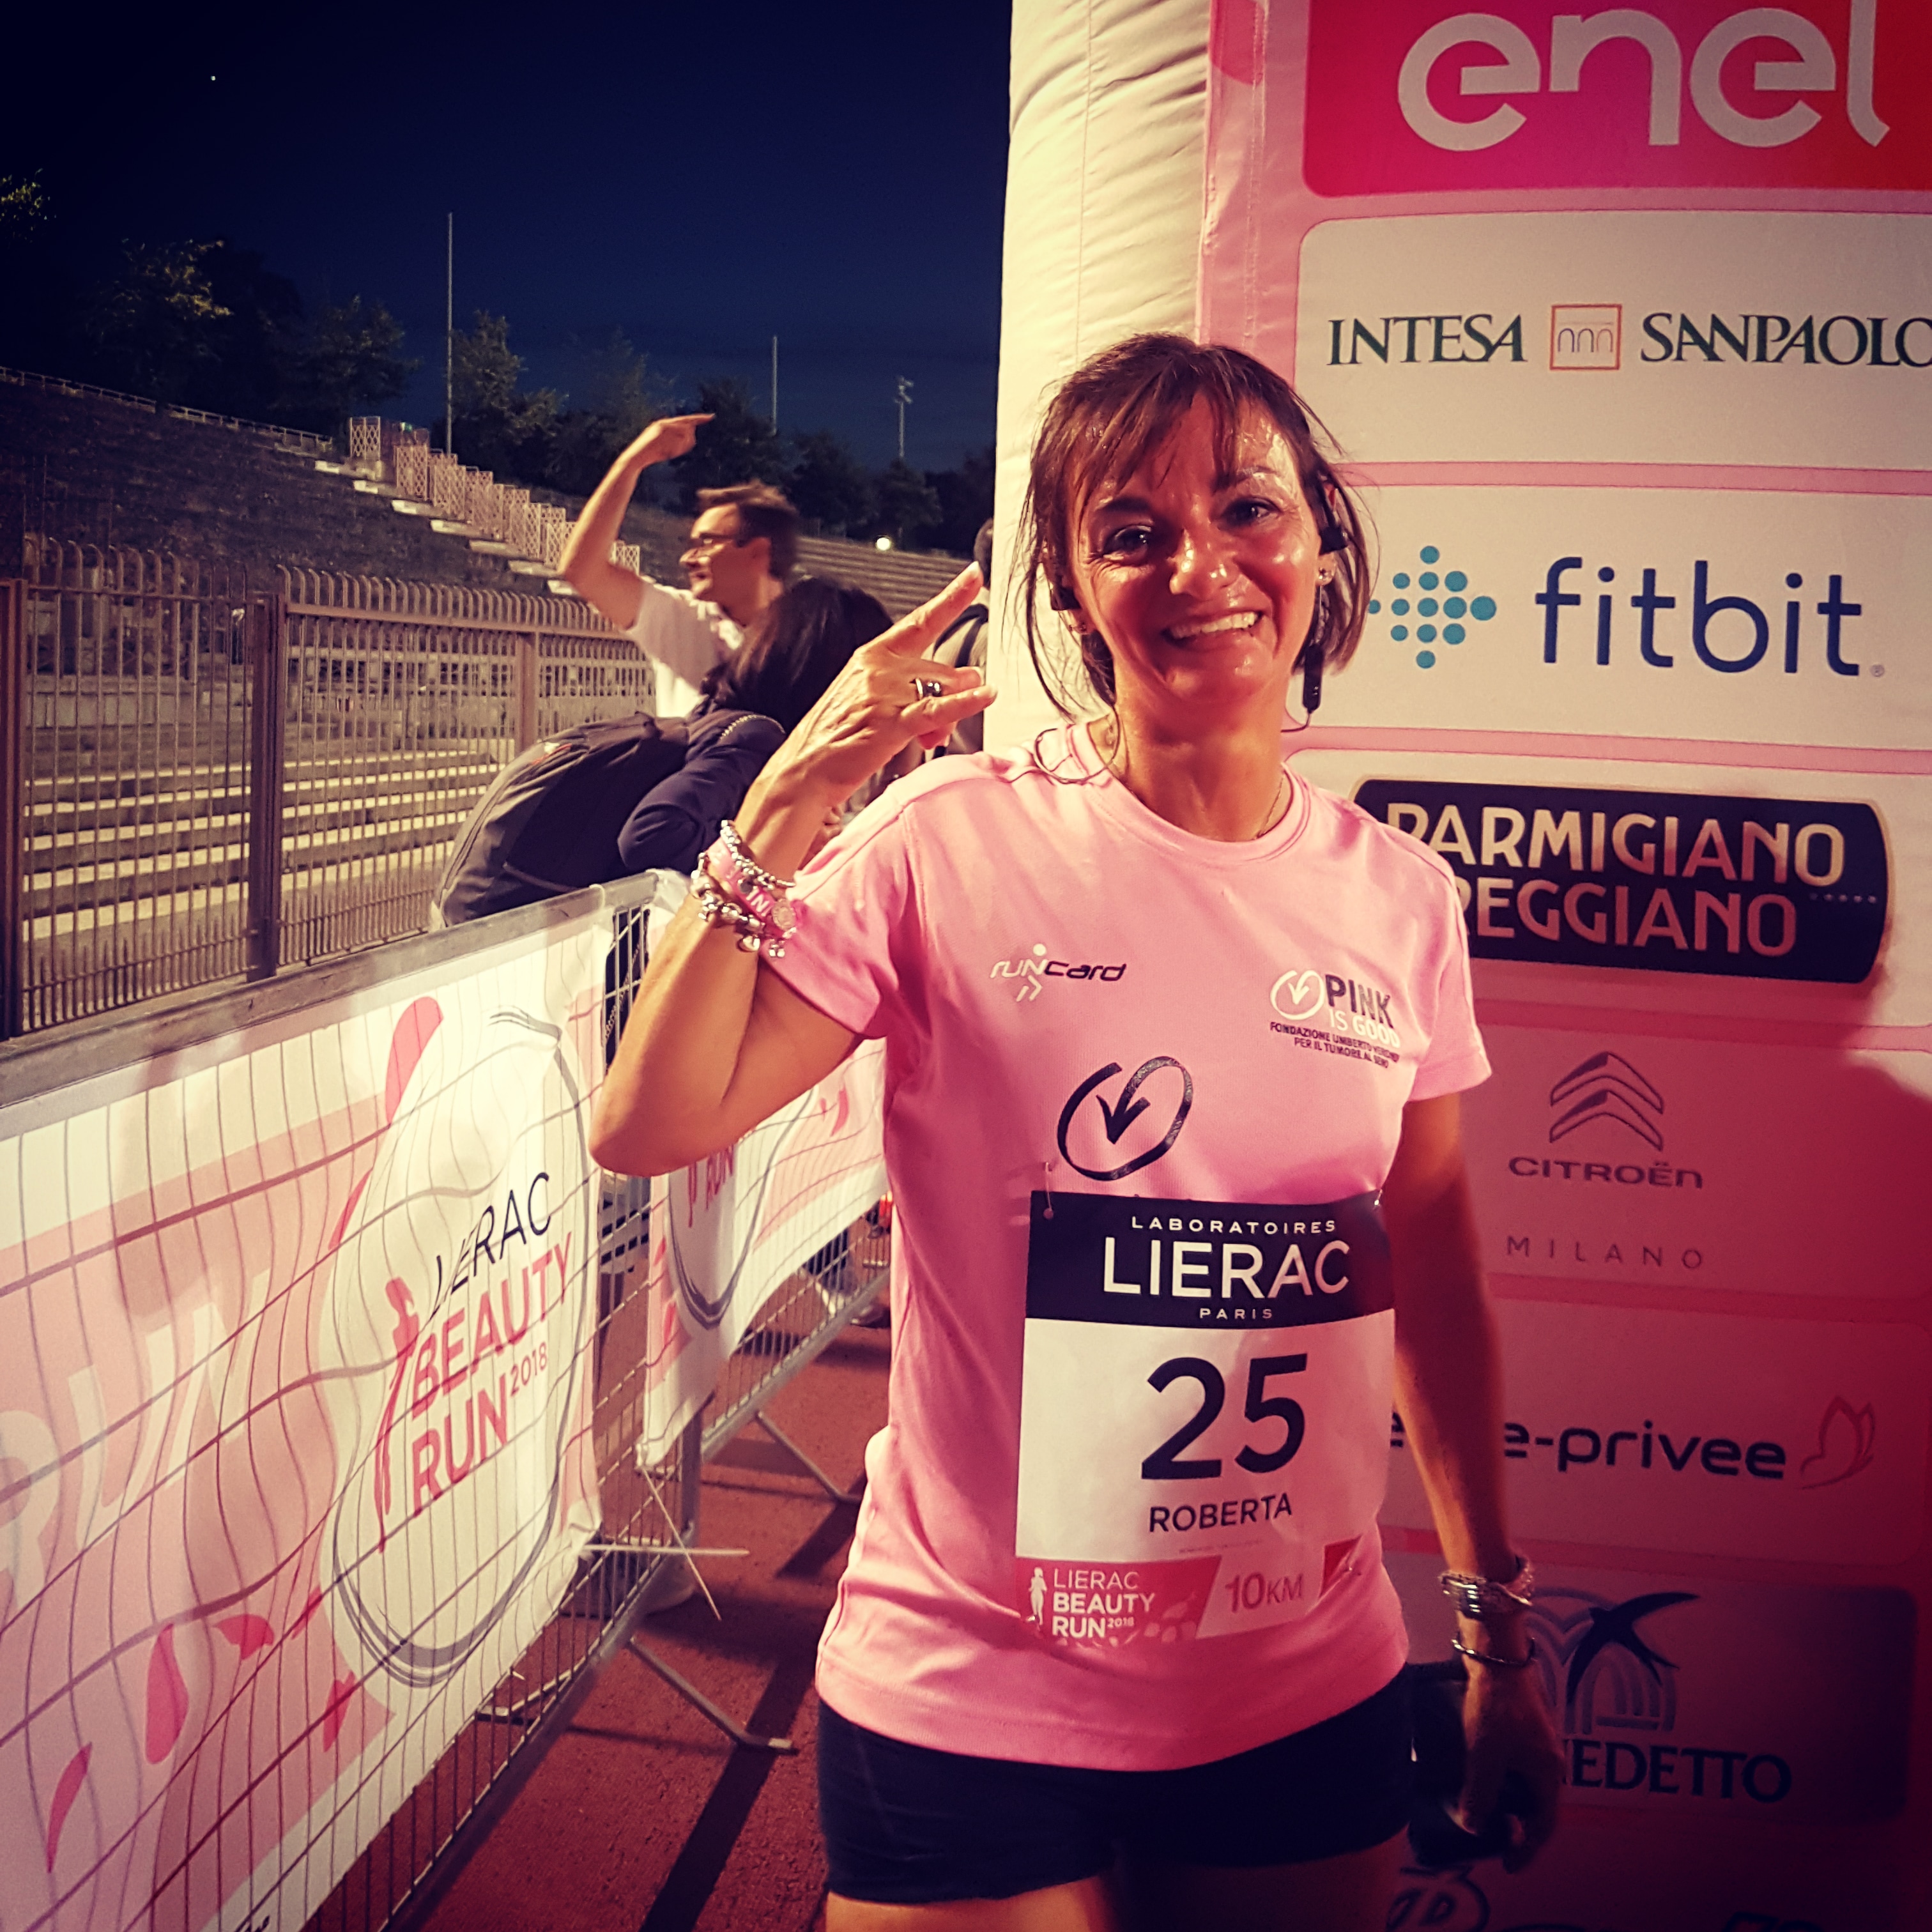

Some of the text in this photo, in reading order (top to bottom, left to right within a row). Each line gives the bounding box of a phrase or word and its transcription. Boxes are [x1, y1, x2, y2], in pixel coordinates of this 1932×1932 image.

[1397, 0, 1890, 152] enel
[1326, 311, 1932, 369] INTESA SANPAOLO
[1535, 556, 1862, 677] fitbit
[1387, 802, 1846, 887] PARMIGIANO
[1324, 973, 1394, 1029] PINK
[1328, 1008, 1401, 1049] IS GOOD
[1131, 1216, 1337, 1234] LABORATOIRES
[1506, 1235, 1703, 1269] MILANO
[1103, 1236, 1351, 1300] LIERAC
[411, 1230, 572, 1422] BEAUTY
[1199, 1308, 1273, 1320] PARIS
[411, 1341, 548, 1519] RUN 2018
[1140, 1353, 1308, 1480] 25
[1149, 1493, 1293, 1533] ROBERTA
[1053, 1567, 1140, 1590] LIERAC
[1053, 1591, 1156, 1615] BEAUTY
[1224, 1571, 1305, 1613] 10KM
[1052, 1615, 1106, 1639] RUN
[1563, 1738, 1792, 1804] EDETTO
